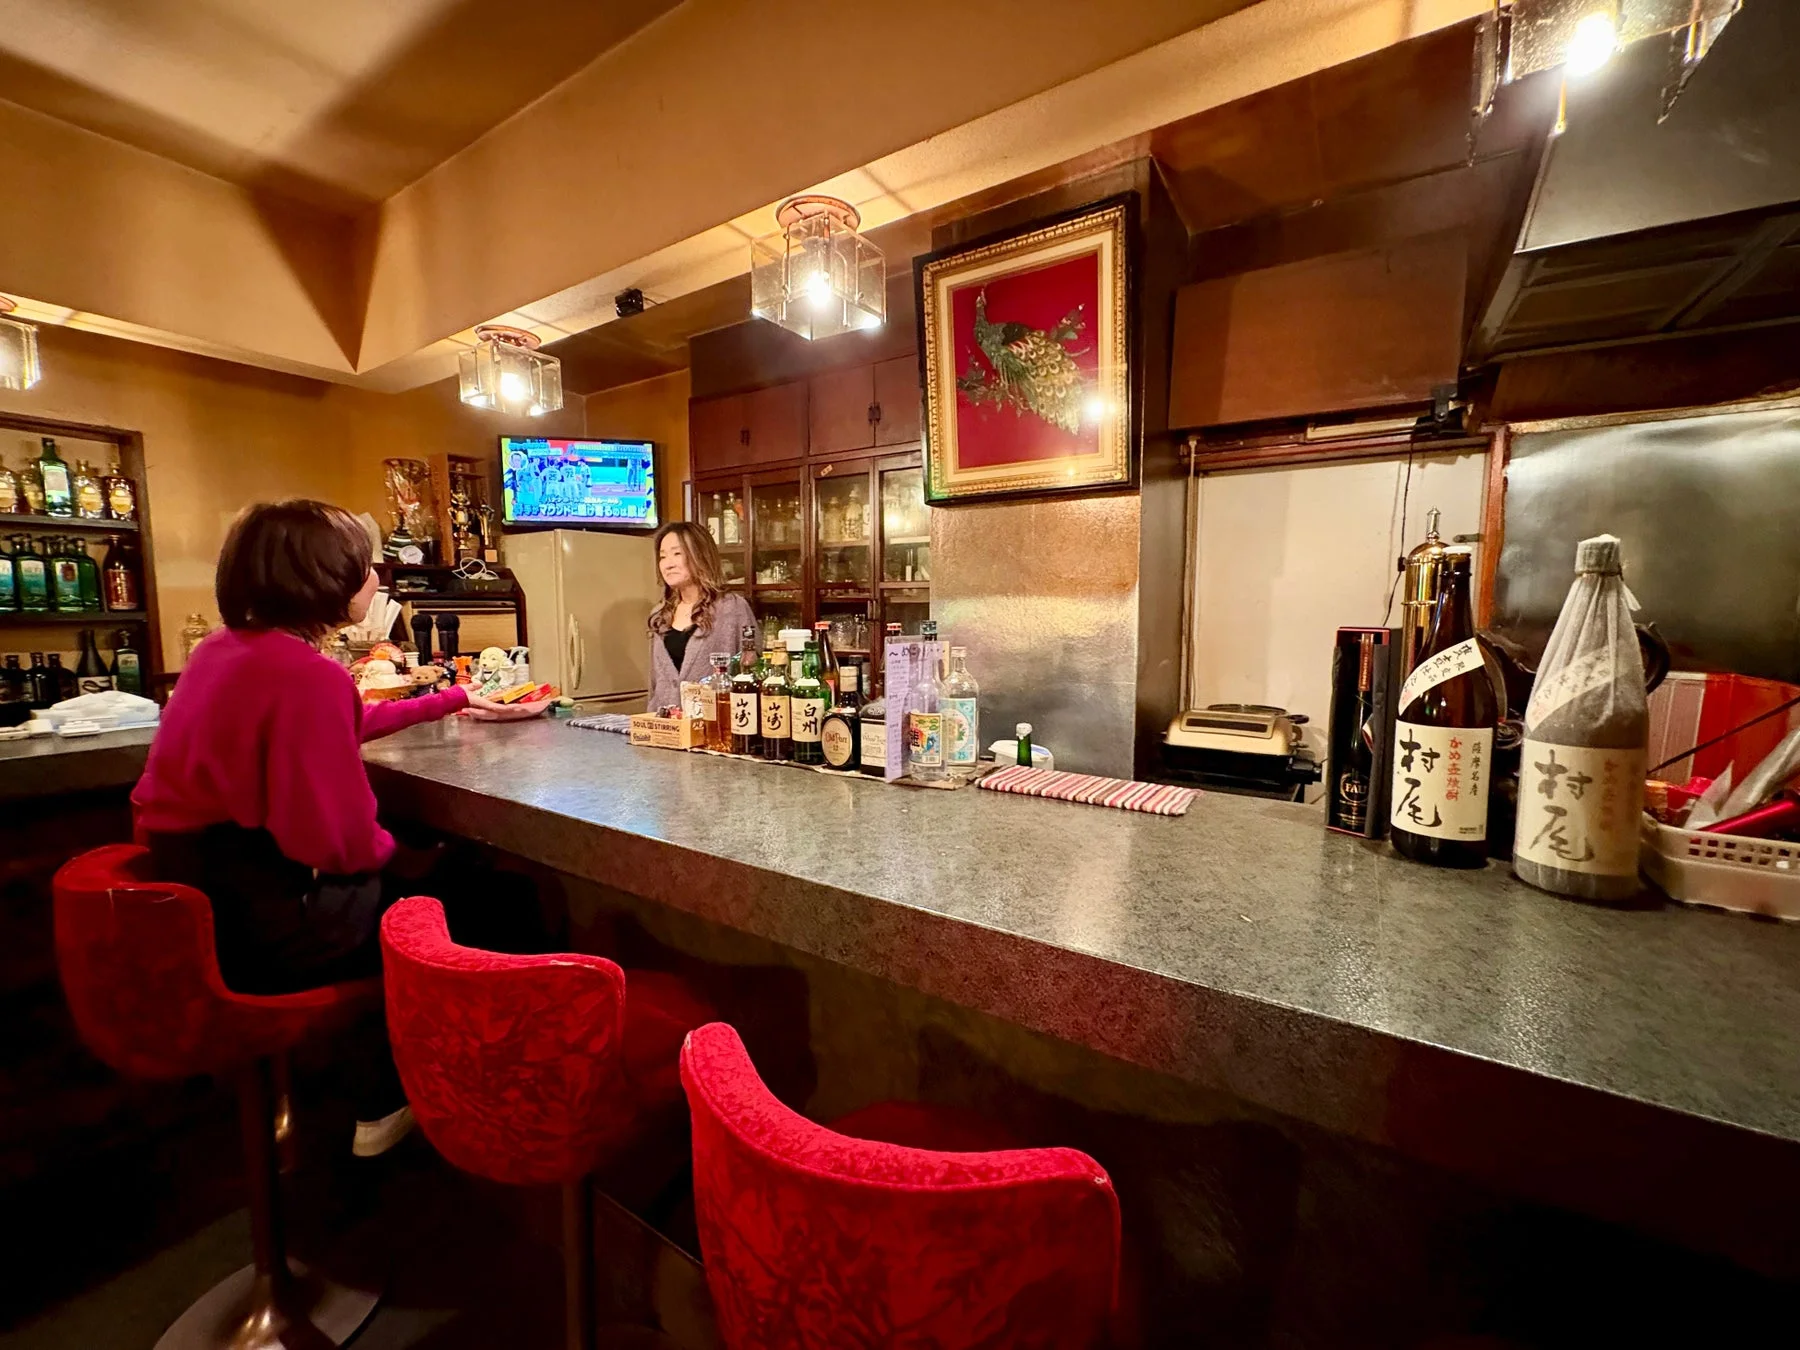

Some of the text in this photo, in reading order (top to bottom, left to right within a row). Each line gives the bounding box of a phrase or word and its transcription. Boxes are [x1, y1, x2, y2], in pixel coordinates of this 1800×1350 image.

[654, 723, 680, 733] STIRRING
[735, 698, 751, 728] 山崎
[767, 701, 783, 731] 山崎
[802, 703, 818, 736] 白州
[1396, 728, 1442, 828] 村尾
[1528, 748, 1594, 862] 村尾
